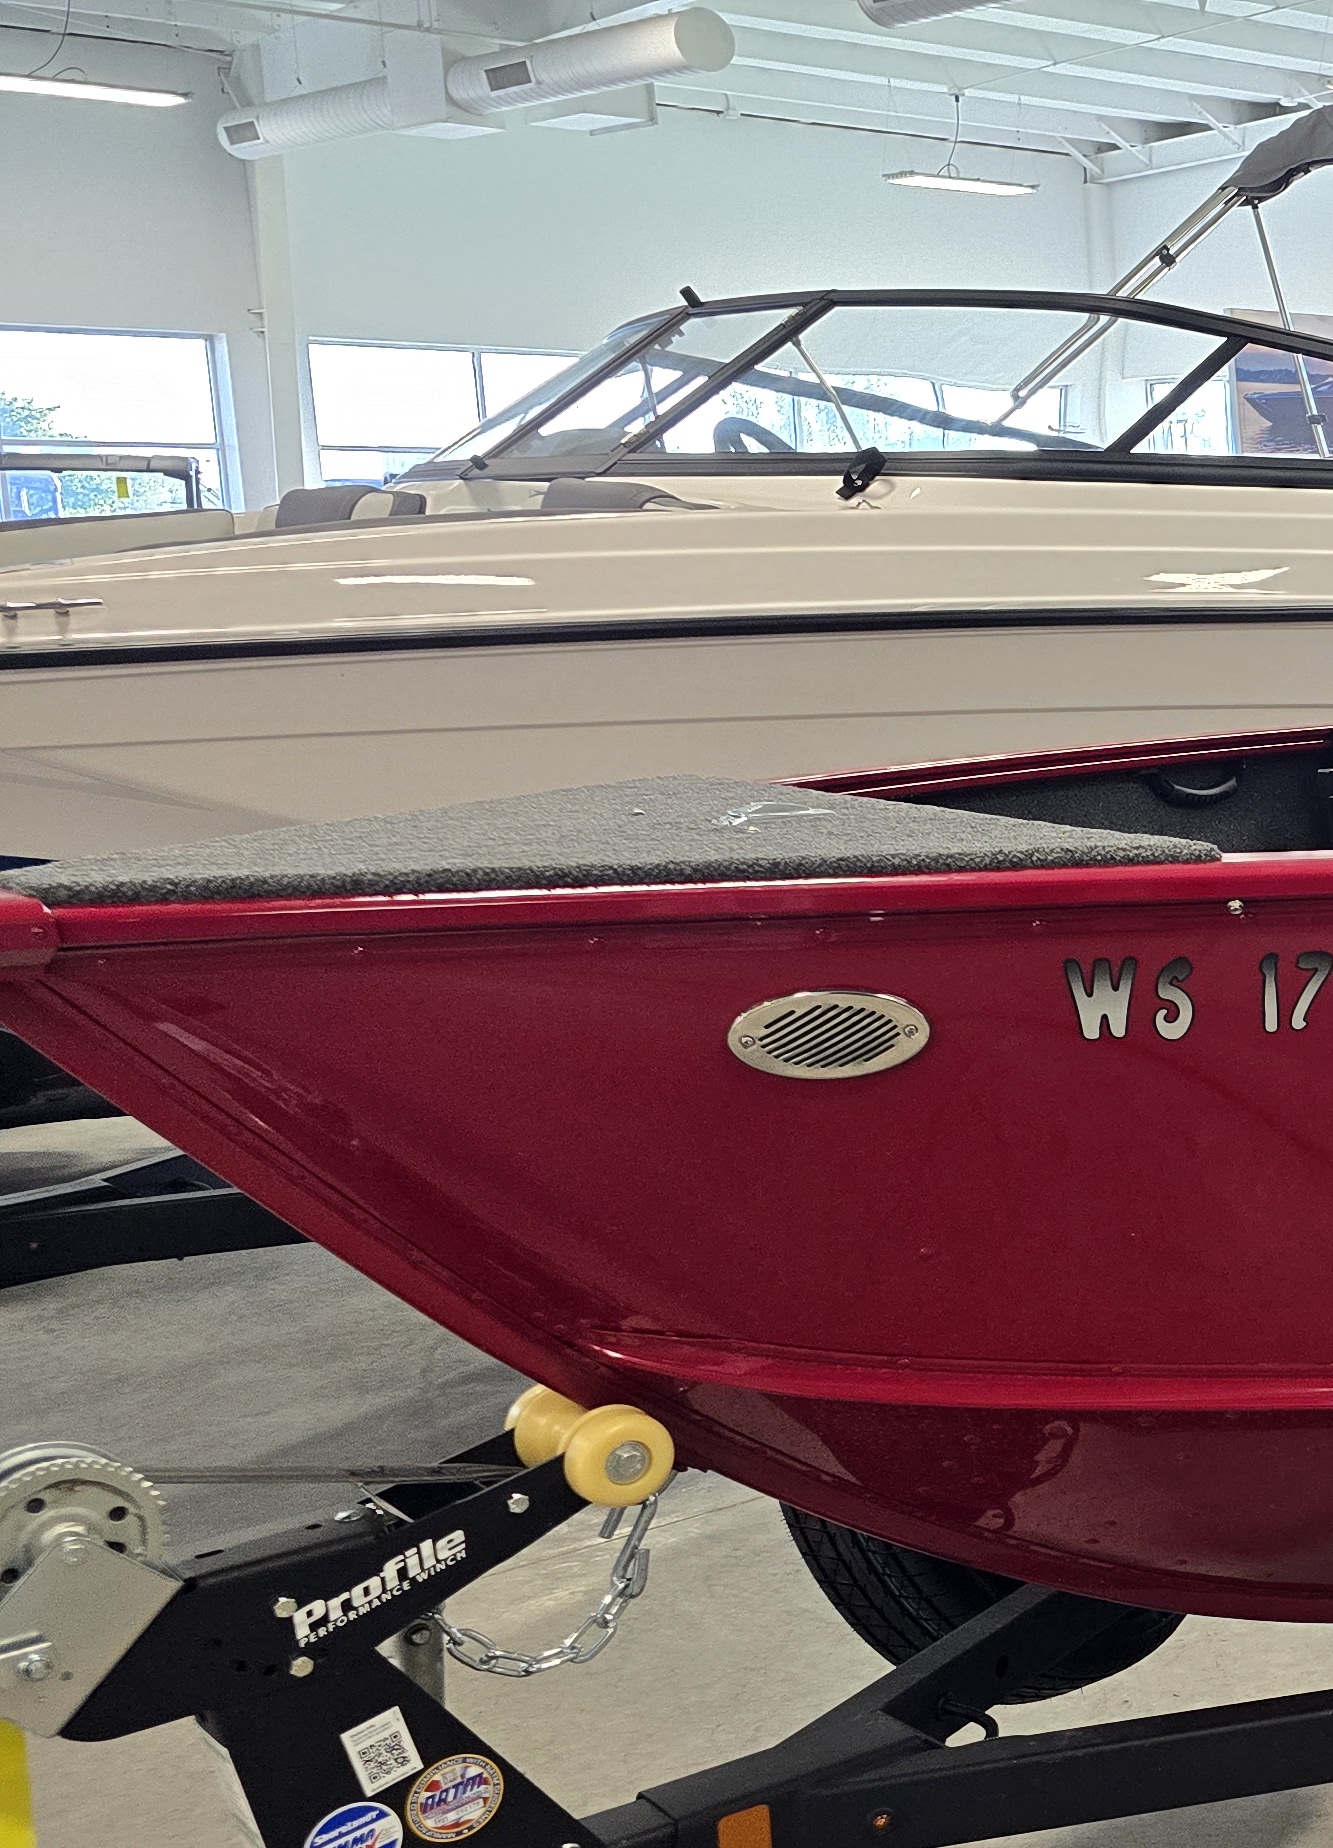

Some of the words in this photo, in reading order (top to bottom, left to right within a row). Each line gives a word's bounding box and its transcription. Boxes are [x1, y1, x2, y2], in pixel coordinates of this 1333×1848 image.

[1063, 956, 1195, 1041] WS
[292, 1529, 466, 1641] Profile
[298, 1579, 411, 1648] PERFORMANCE
[415, 1550, 467, 1583] WINCH
